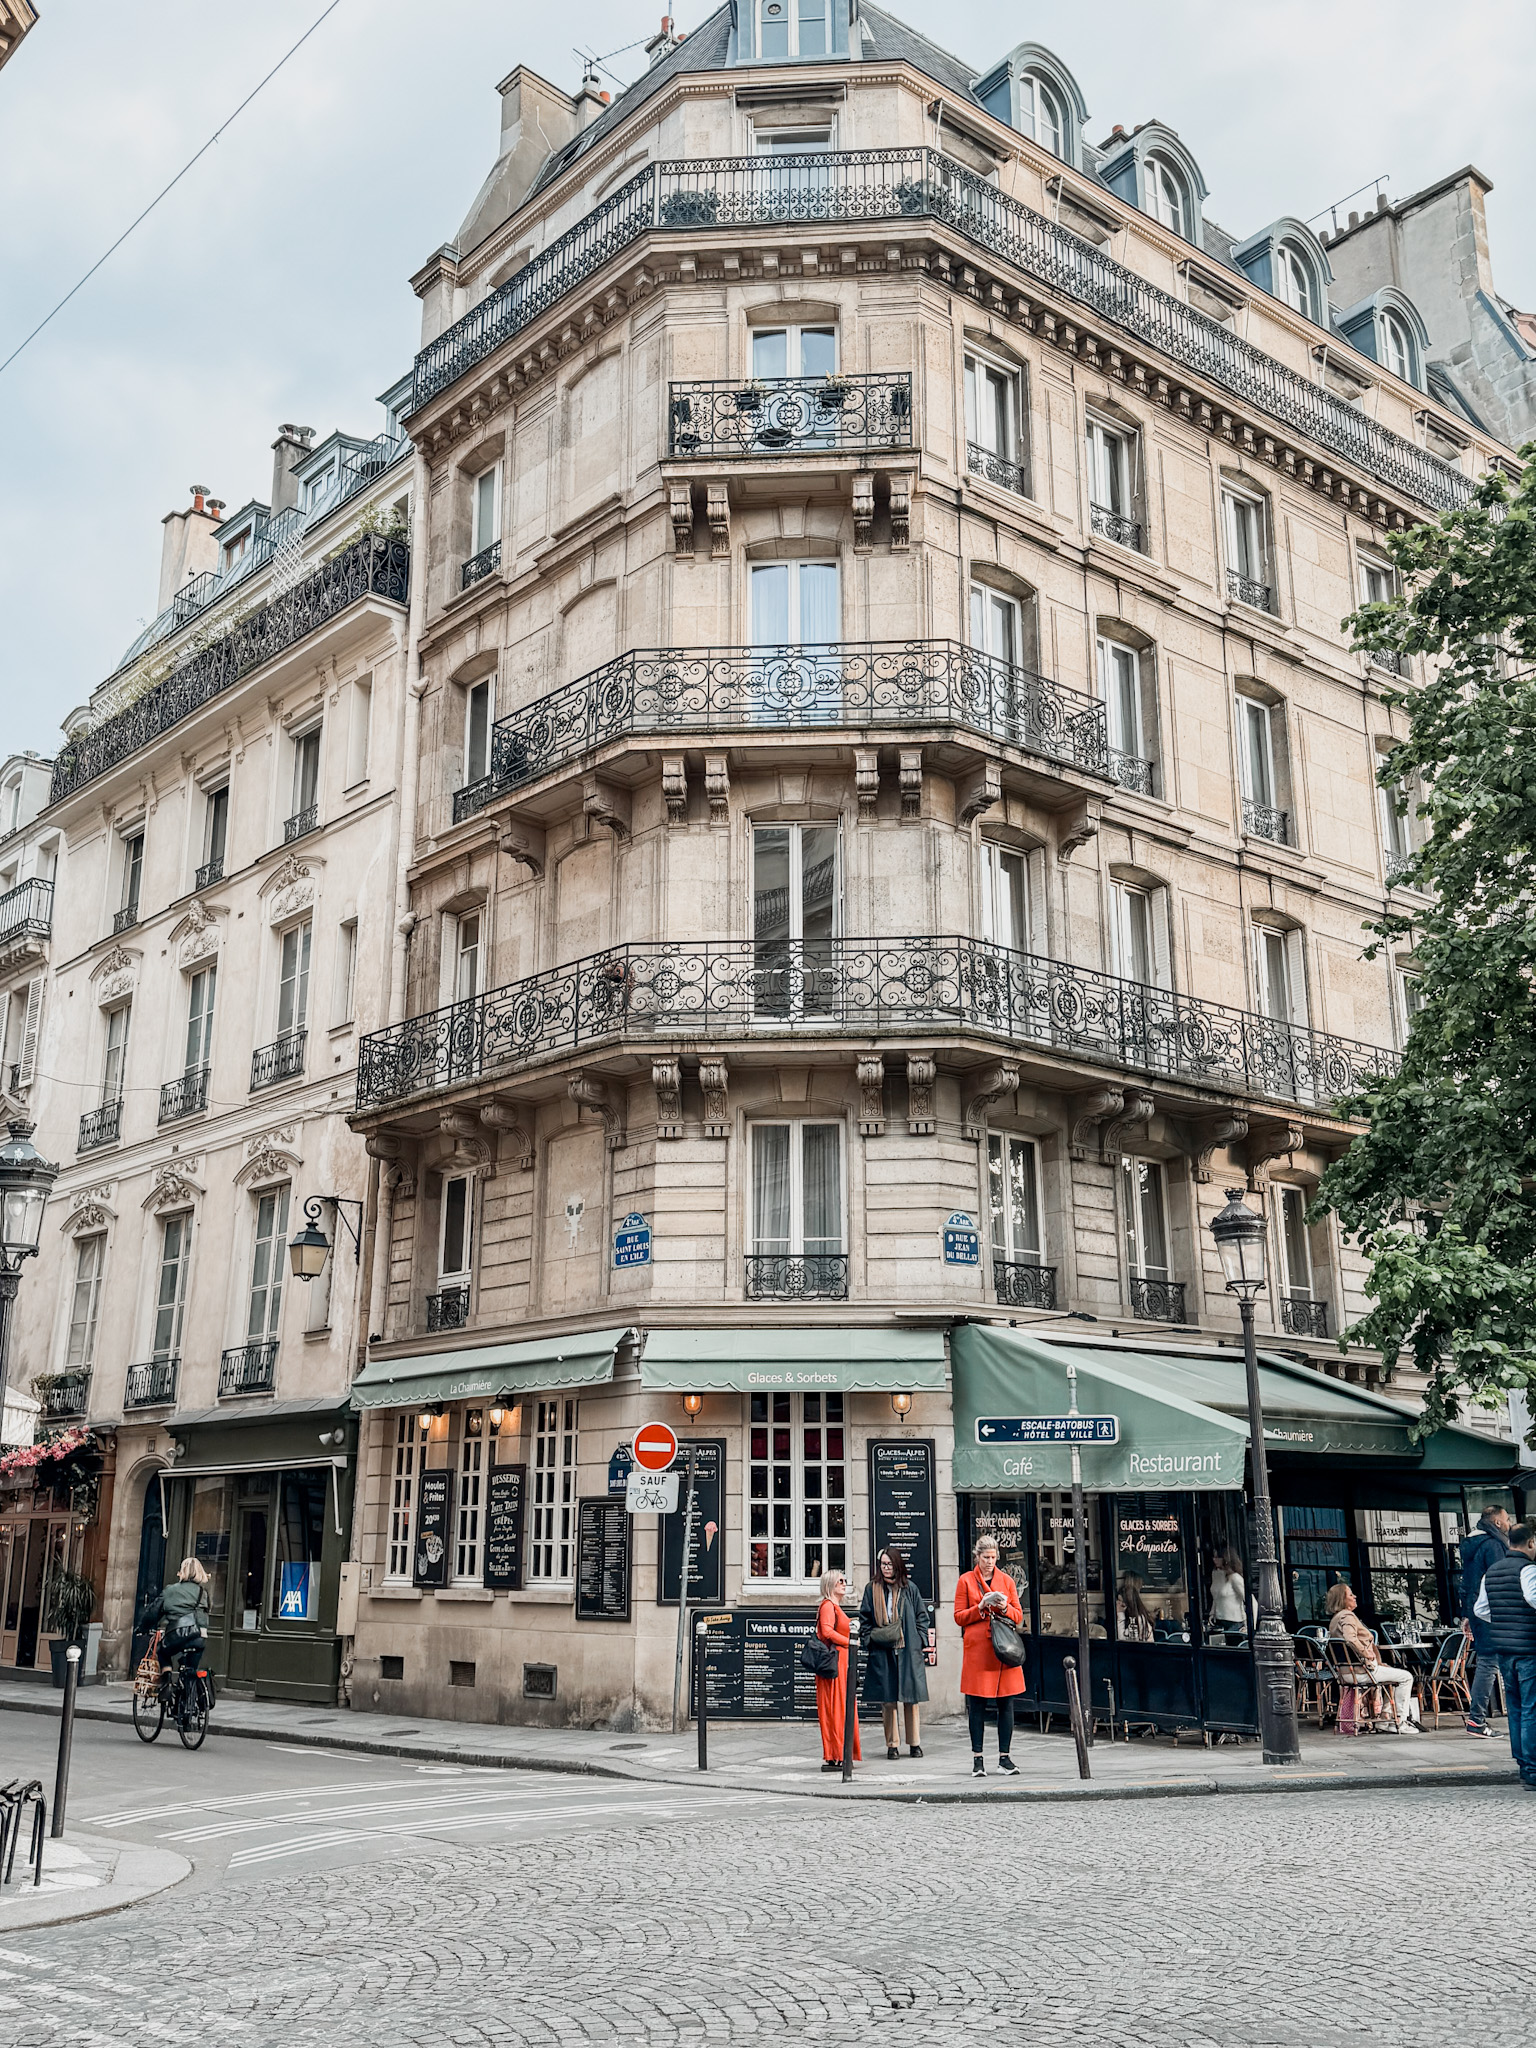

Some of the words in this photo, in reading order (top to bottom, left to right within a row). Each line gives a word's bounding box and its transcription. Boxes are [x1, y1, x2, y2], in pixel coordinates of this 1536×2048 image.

[626, 1235, 639, 1244] RUE
[955, 1233, 969, 1242] RUE
[616, 1245, 632, 1255] SAINT
[632, 1242, 649, 1252] LOUIS
[954, 1243, 970, 1252] JEAN
[620, 1254, 629, 1263] EN
[946, 1251, 955, 1259] DU
[955, 1252, 978, 1261] BELLAY
[747, 1372, 783, 1383] Glaces
[785, 1372, 795, 1383] &
[796, 1372, 838, 1383] Sorbets
[1023, 1430, 1050, 1439] HÔTEL
[1054, 1431, 1066, 1439] DE
[1070, 1430, 1093, 1439] VILLE
[1003, 1456, 1033, 1476] Café
[1129, 1452, 1222, 1473] Restaurant
[491, 1473, 521, 1486] DESSERTS
[640, 1476, 667, 1486] SAUF
[424, 1481, 446, 1491] Moules
[429, 1492, 445, 1502] Frites
[975, 1518, 997, 1528] SERVICE
[998, 1518, 1021, 1528] CONTINU
[1050, 1518, 1089, 1528] BREAKT
[1120, 1520, 1144, 1531] GLACES
[1145, 1520, 1151, 1531] &
[1152, 1520, 1178, 1531] SORBETS
[1136, 1535, 1178, 1559] Emporter
[280, 1590, 303, 1613] AXA
[751, 1623, 778, 1633] Vente
[780, 1623, 787, 1633] à
